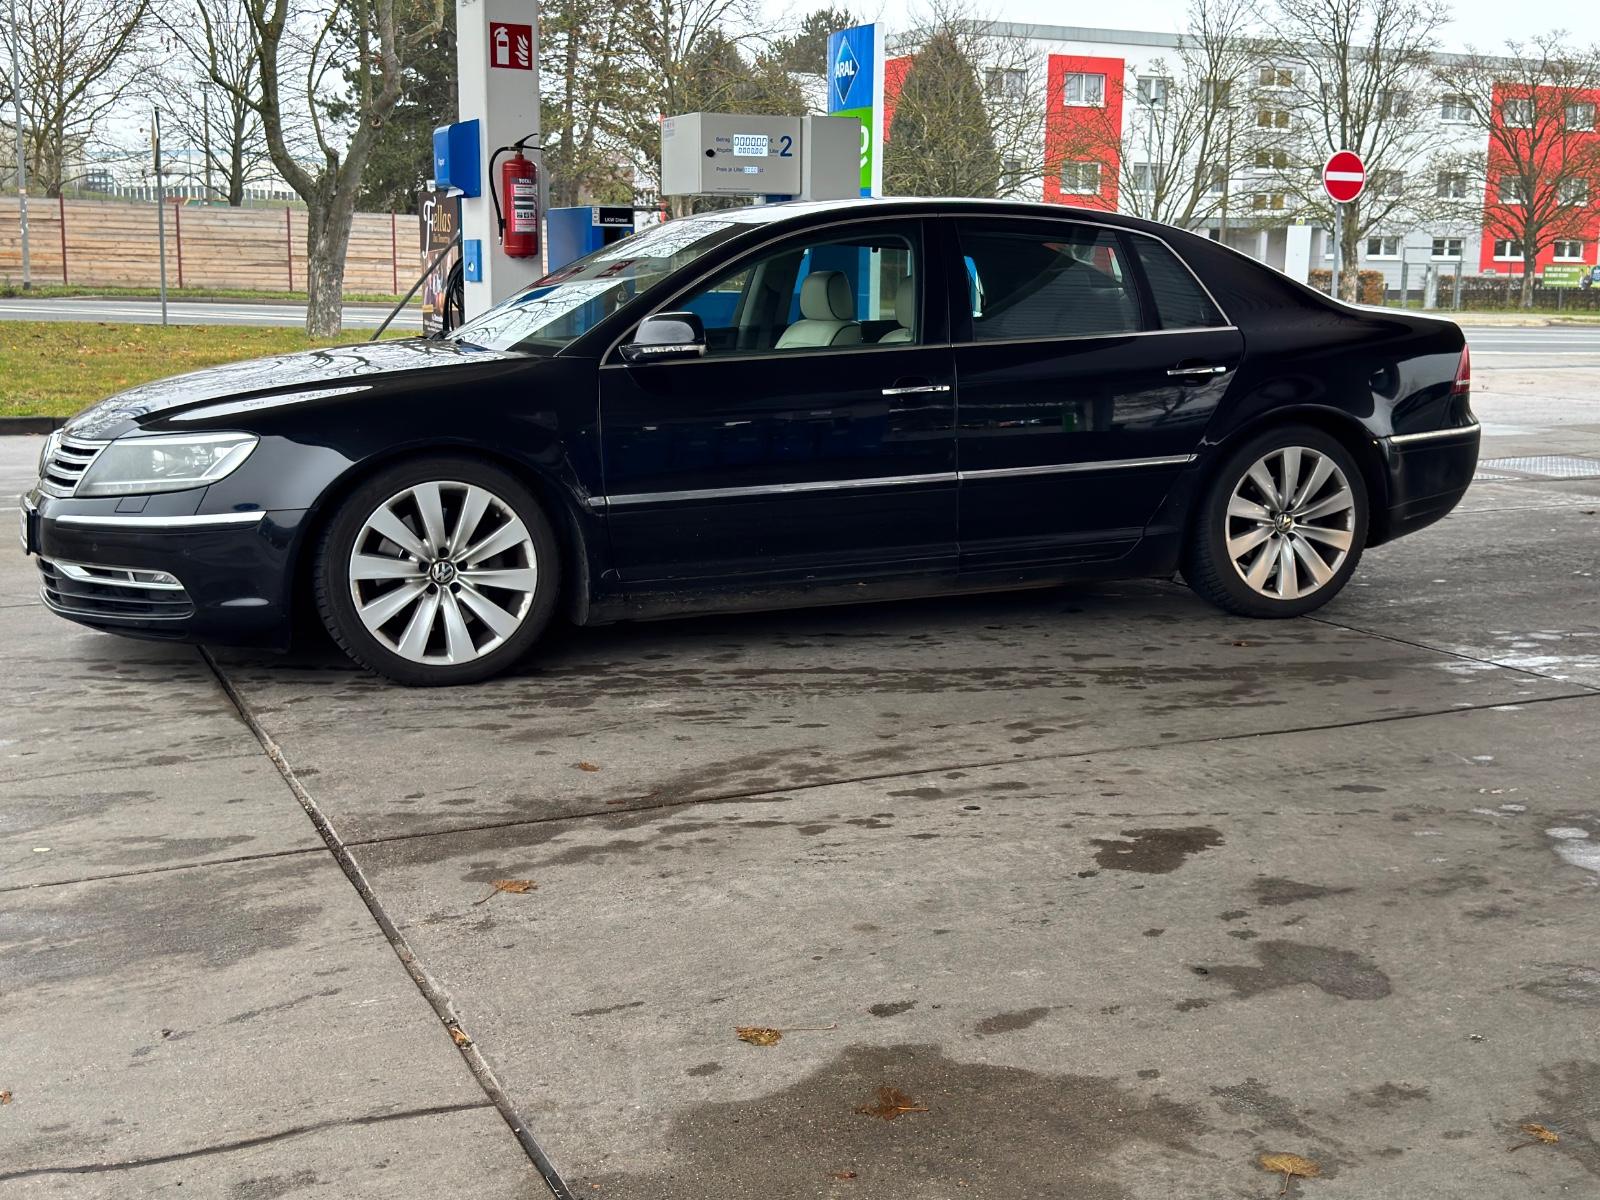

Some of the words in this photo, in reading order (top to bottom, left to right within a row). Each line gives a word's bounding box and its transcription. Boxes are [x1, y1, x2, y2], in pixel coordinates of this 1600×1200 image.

[835, 59, 855, 78] ARAL
[780, 135, 793, 157] 2
[432, 561, 454, 582] VW
